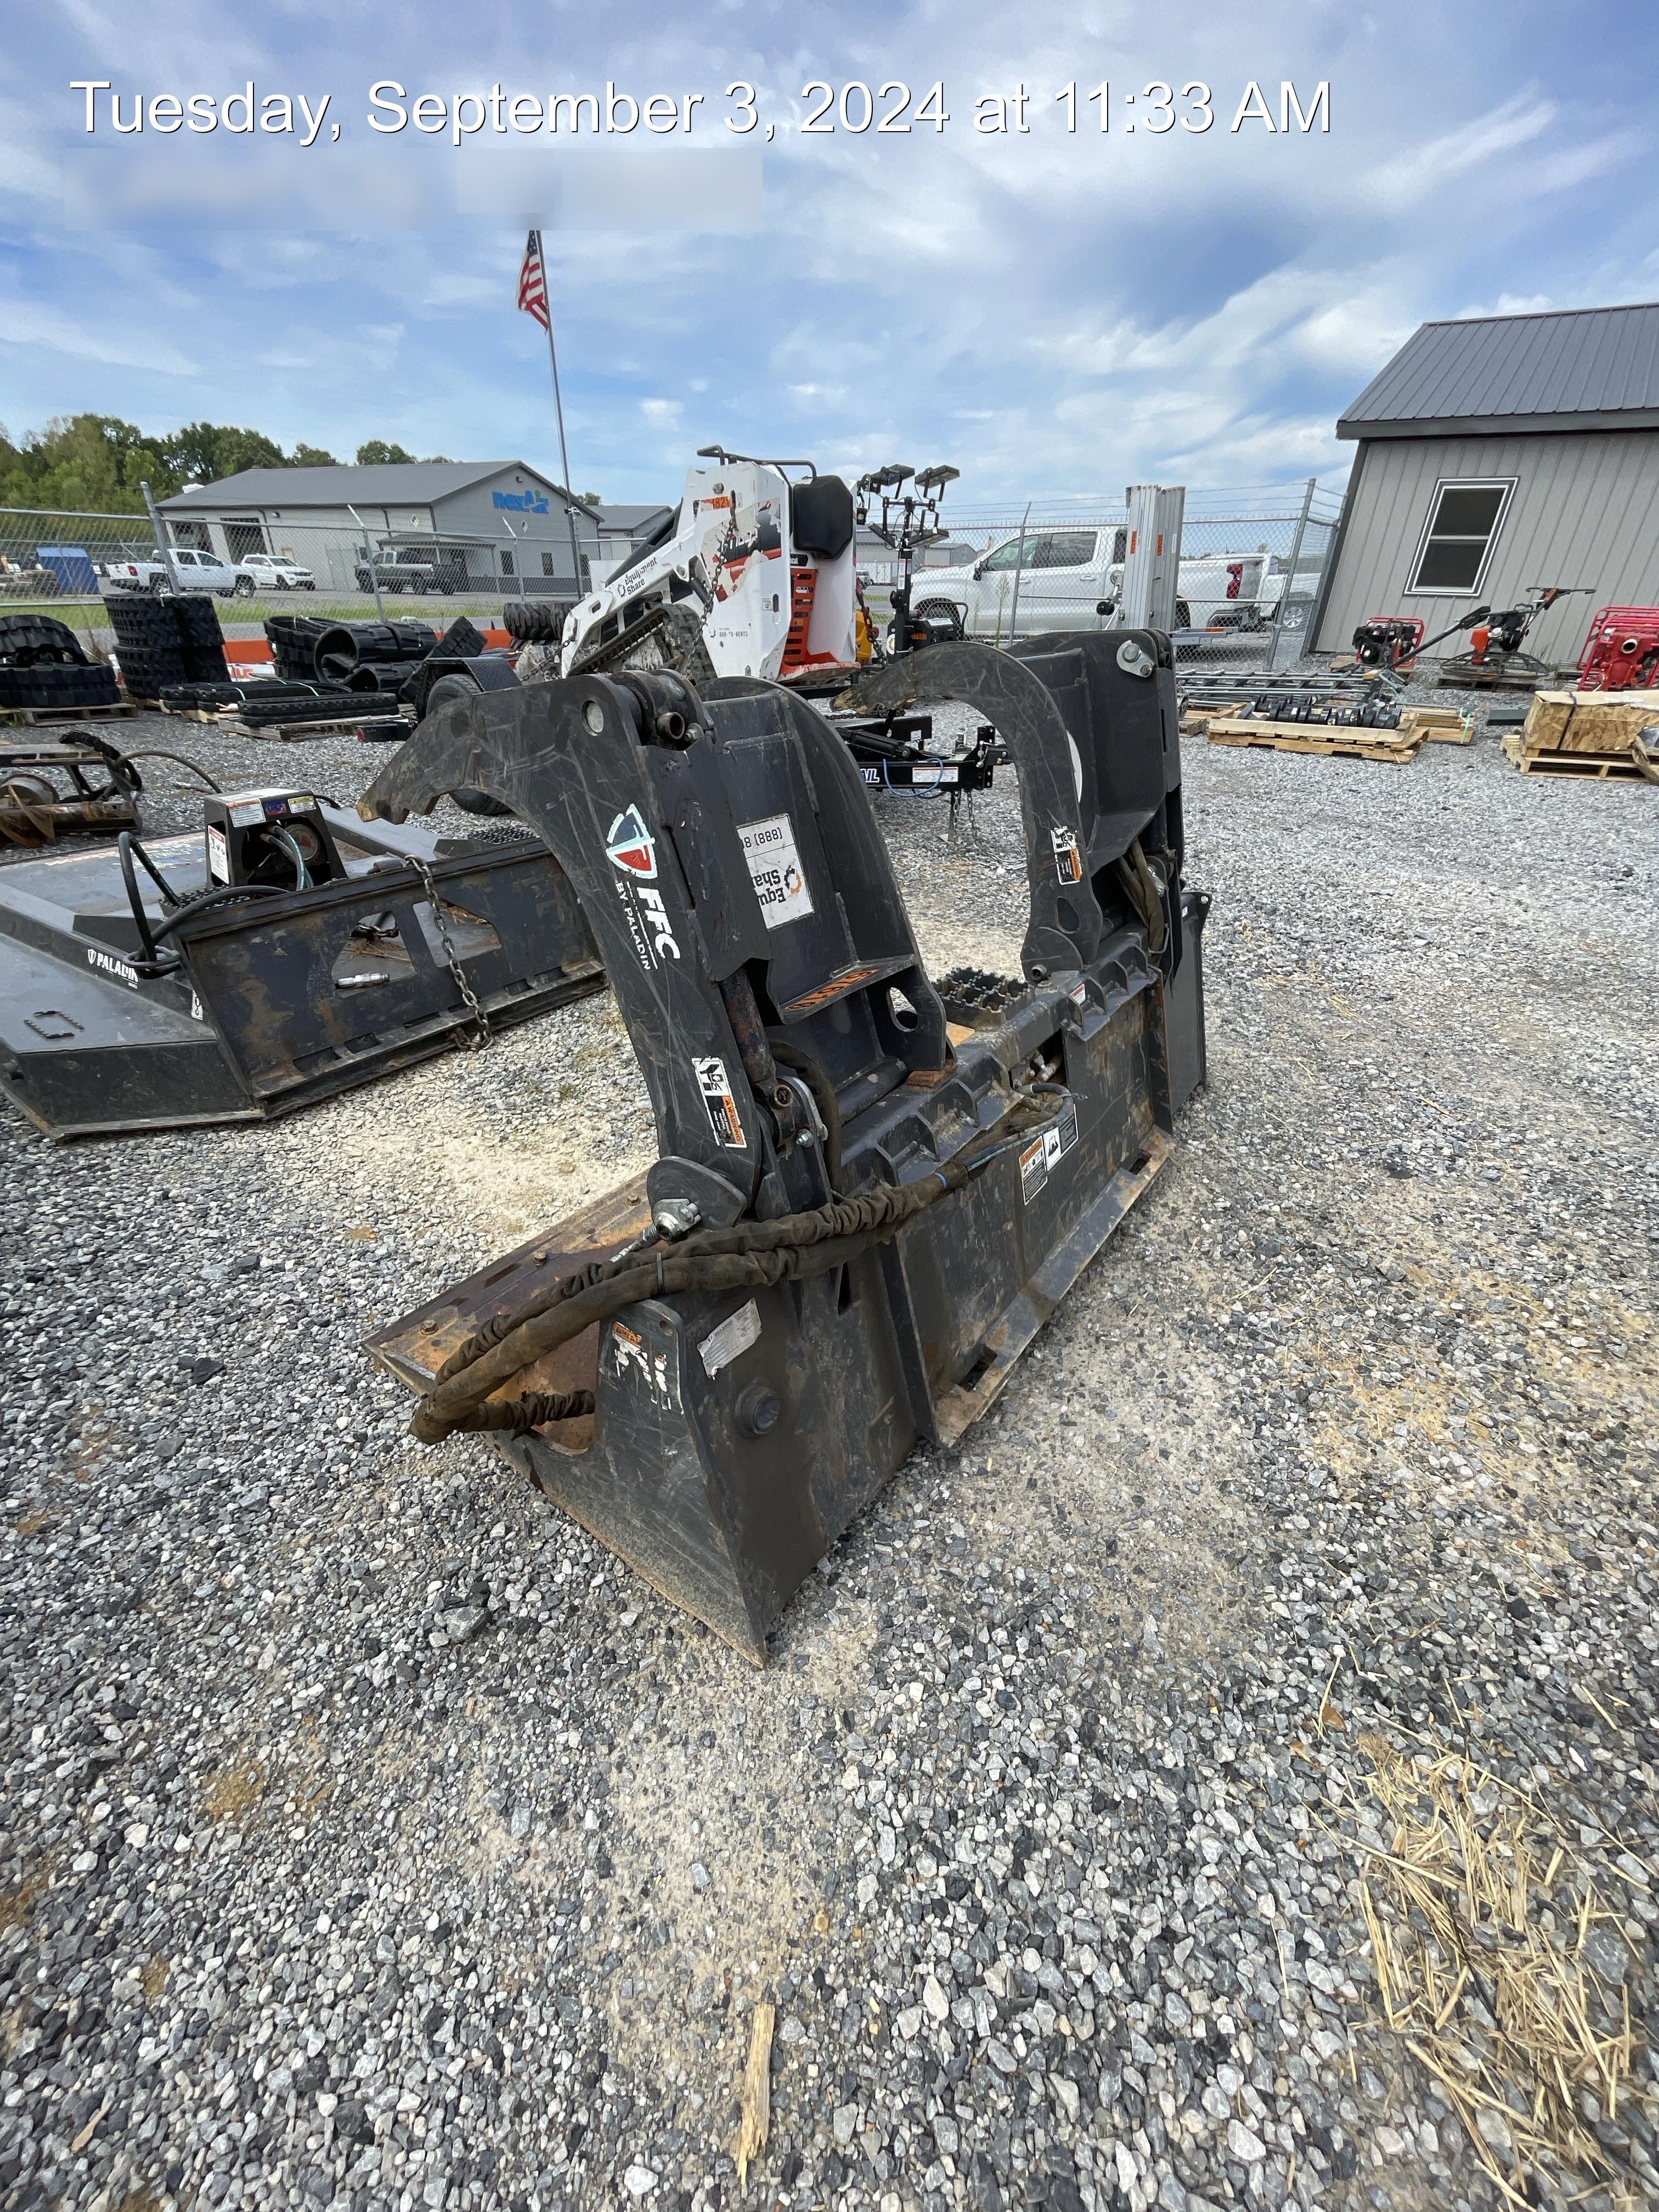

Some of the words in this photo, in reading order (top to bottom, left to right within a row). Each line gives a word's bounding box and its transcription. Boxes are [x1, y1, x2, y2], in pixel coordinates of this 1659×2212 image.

[624, 556, 658, 585] Equipment
[627, 579, 645, 595] Share
[615, 882, 629, 901] BY
[624, 906, 651, 970] PALADIN
[636, 887, 681, 959] FFC
[97, 952, 139, 983] PALADIN
